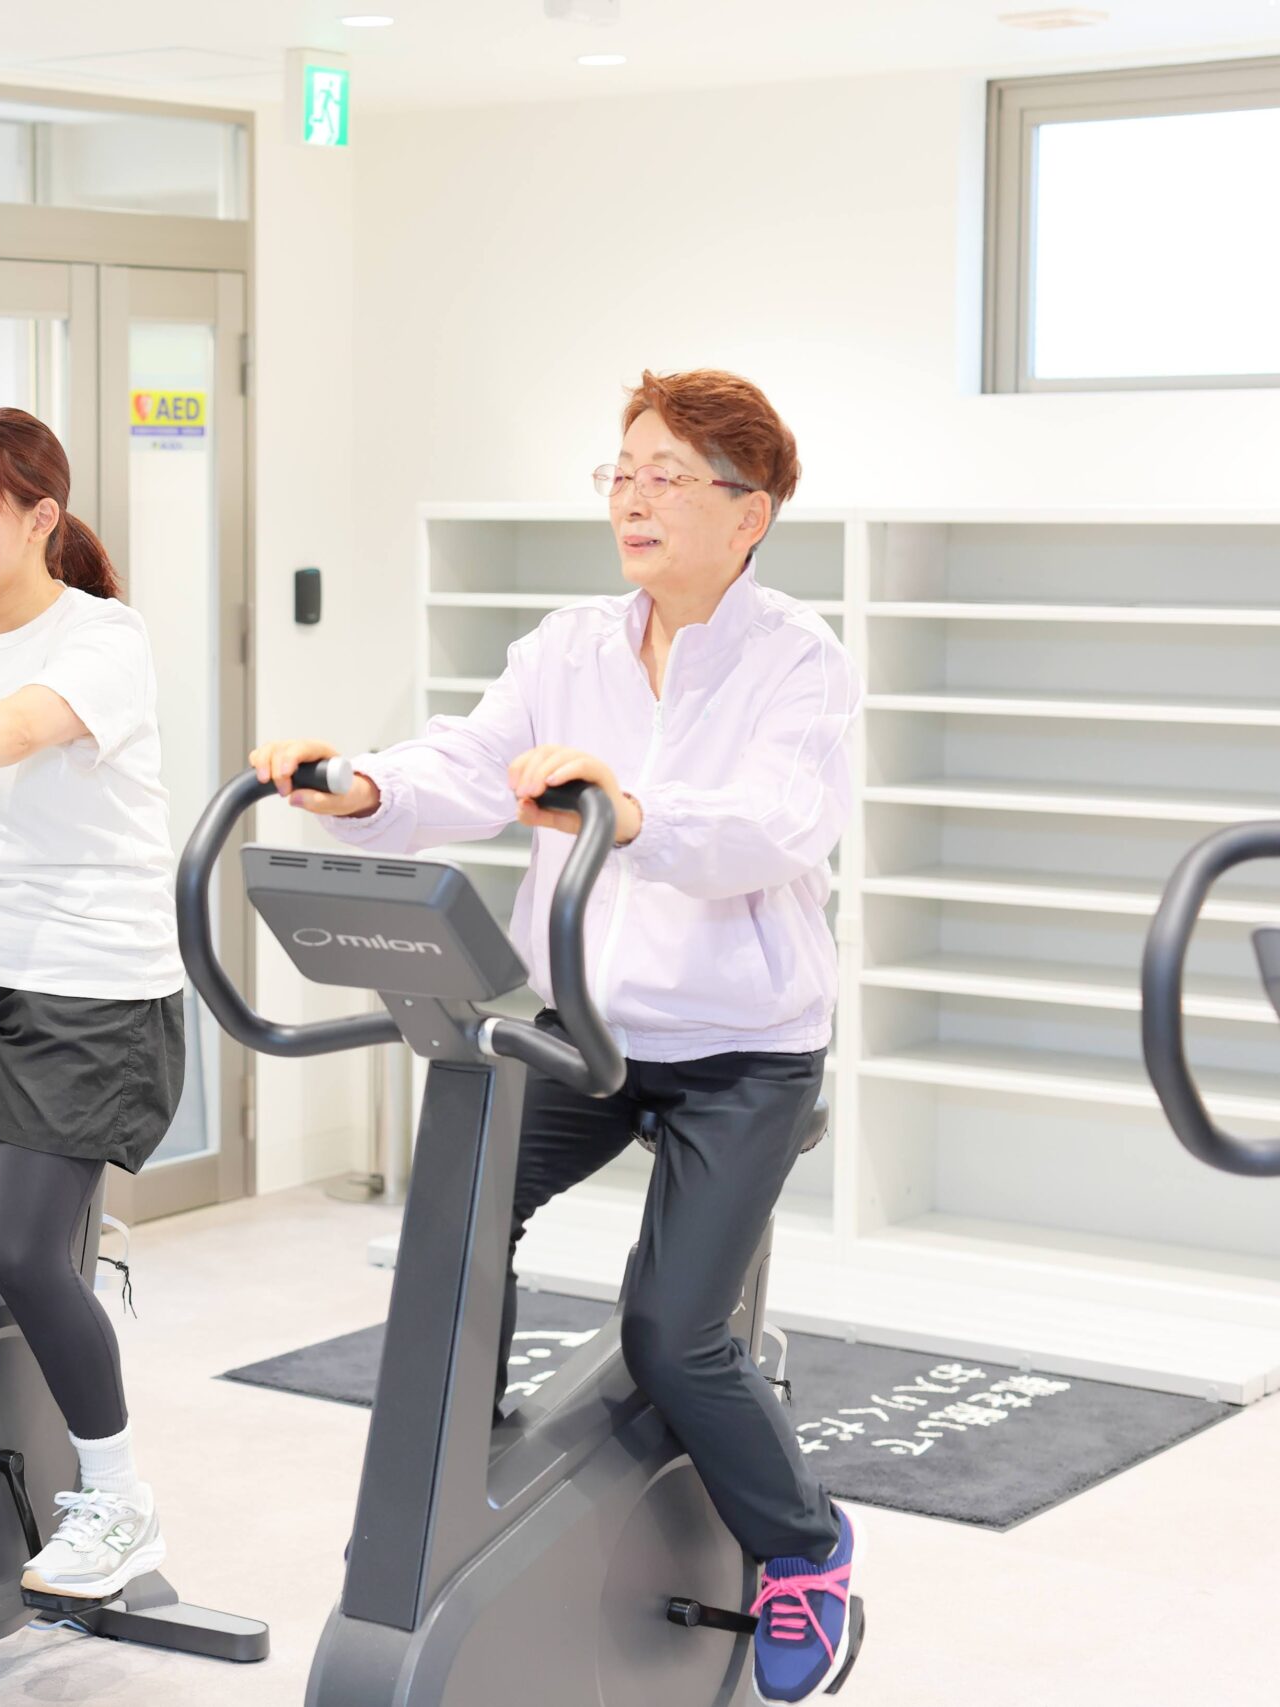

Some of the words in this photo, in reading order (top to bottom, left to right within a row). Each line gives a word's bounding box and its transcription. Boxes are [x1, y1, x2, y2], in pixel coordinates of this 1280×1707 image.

[155, 397, 200, 421] AED
[335, 934, 442, 955] milon
[796, 1362, 987, 1454] お入りくださ
